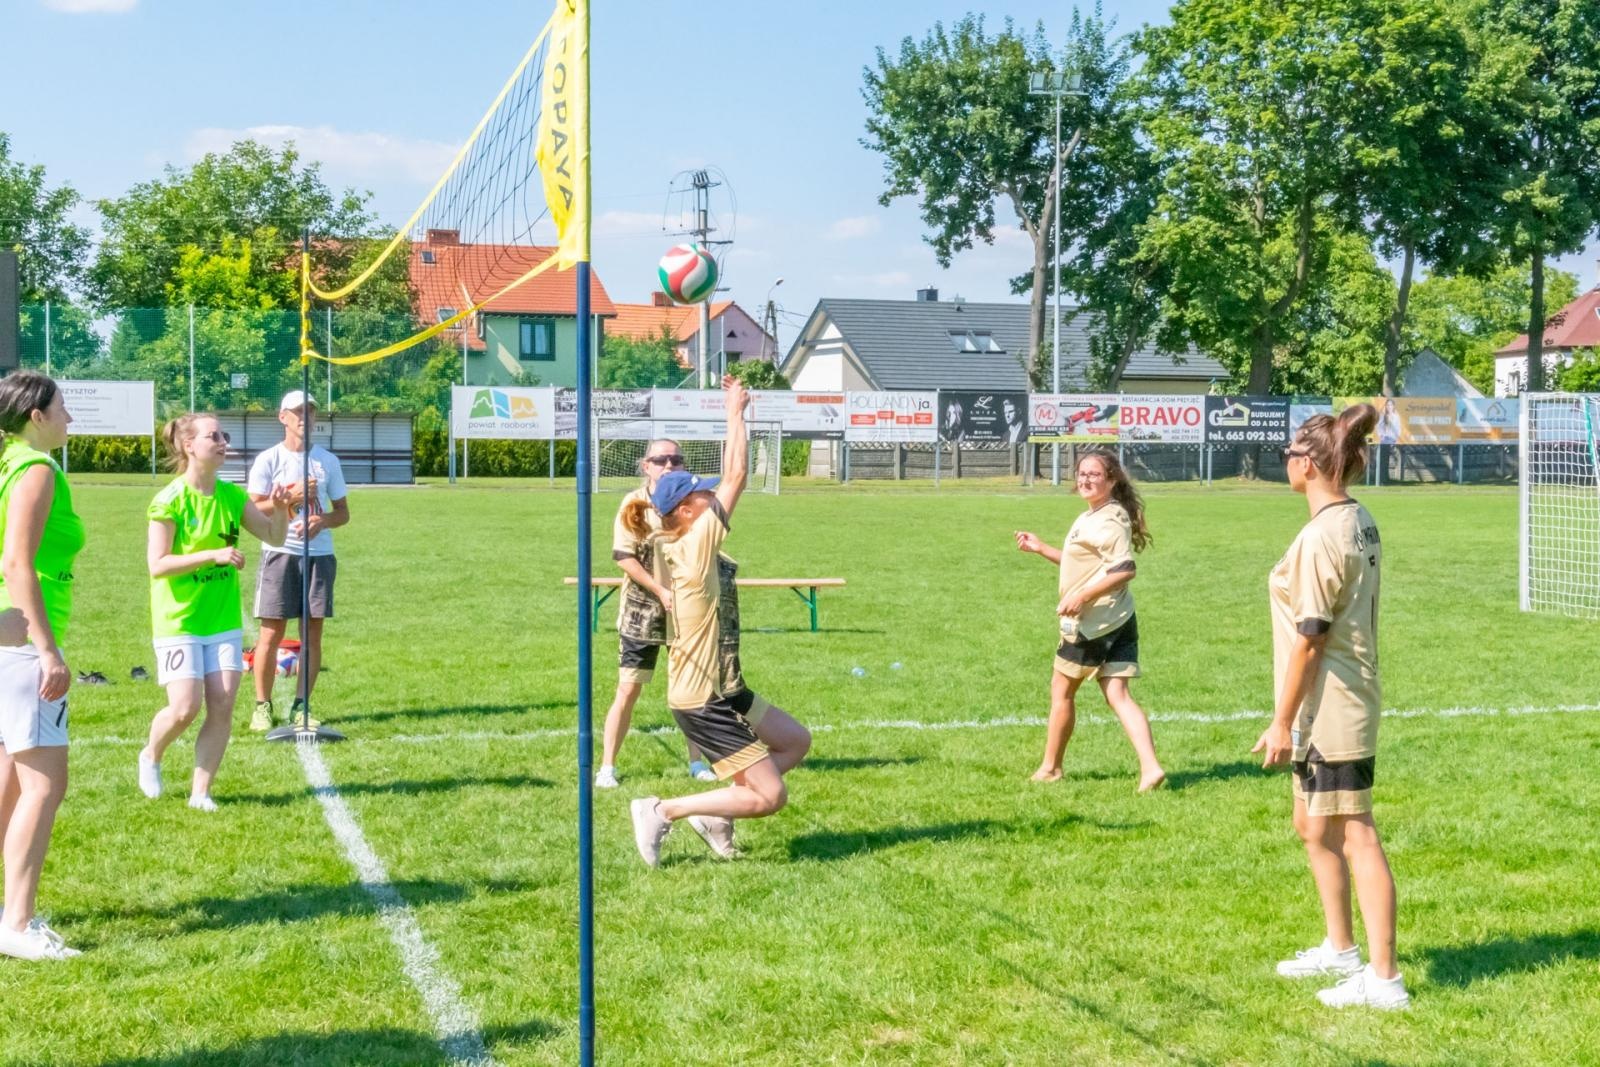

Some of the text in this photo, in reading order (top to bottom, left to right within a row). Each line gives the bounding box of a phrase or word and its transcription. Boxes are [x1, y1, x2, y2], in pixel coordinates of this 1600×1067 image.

[1120, 406, 1201, 426] BRAVO
[468, 421, 496, 430] powiat
[1208, 430, 1224, 441] tel.
[1226, 431, 1244, 441] 665
[1246, 431, 1265, 441] 092
[1267, 431, 1286, 441] 363
[165, 648, 185, 673] 10
